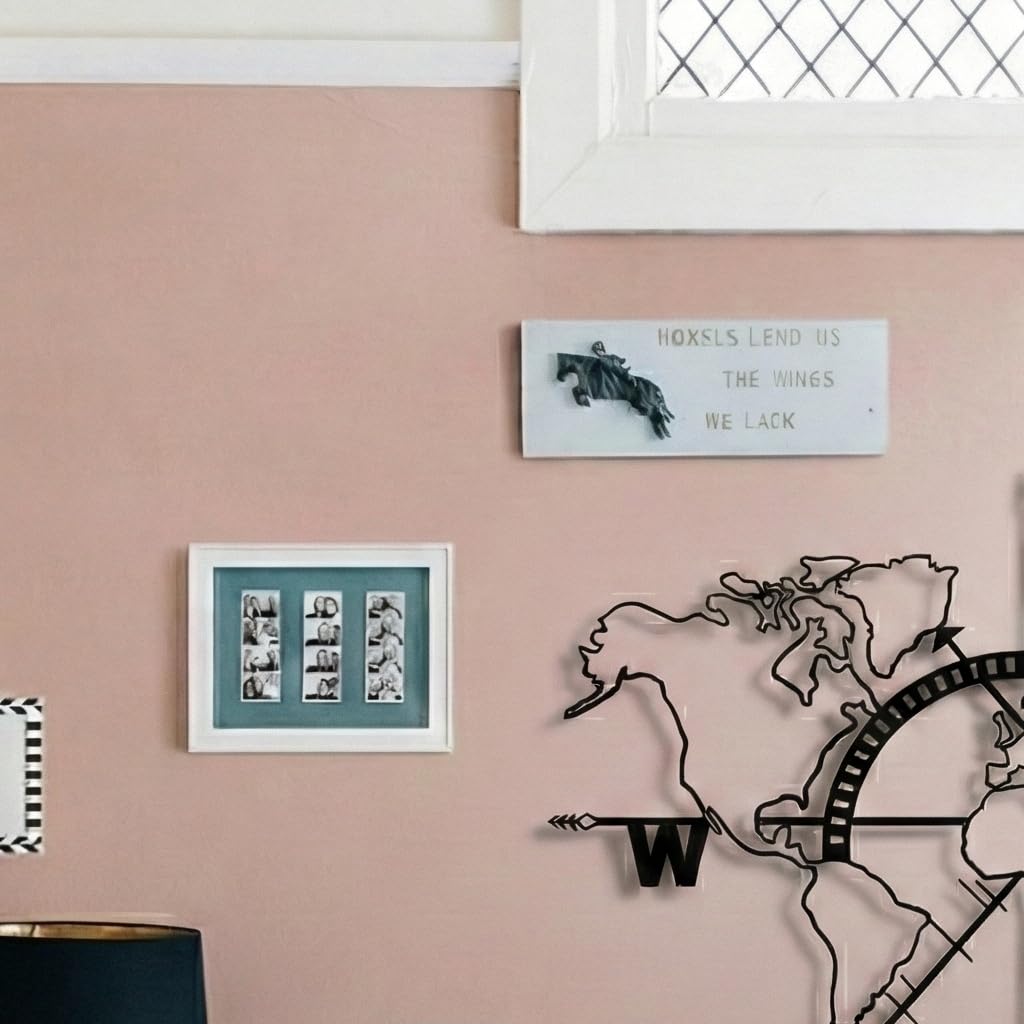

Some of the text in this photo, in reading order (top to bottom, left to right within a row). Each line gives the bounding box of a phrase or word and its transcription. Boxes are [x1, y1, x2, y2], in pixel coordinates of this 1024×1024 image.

[749, 326, 802, 347] LEND
[816, 327, 841, 346] US
[722, 369, 835, 388] THE WINGS
[706, 411, 796, 430] WE LACK
[627, 820, 710, 887] W
